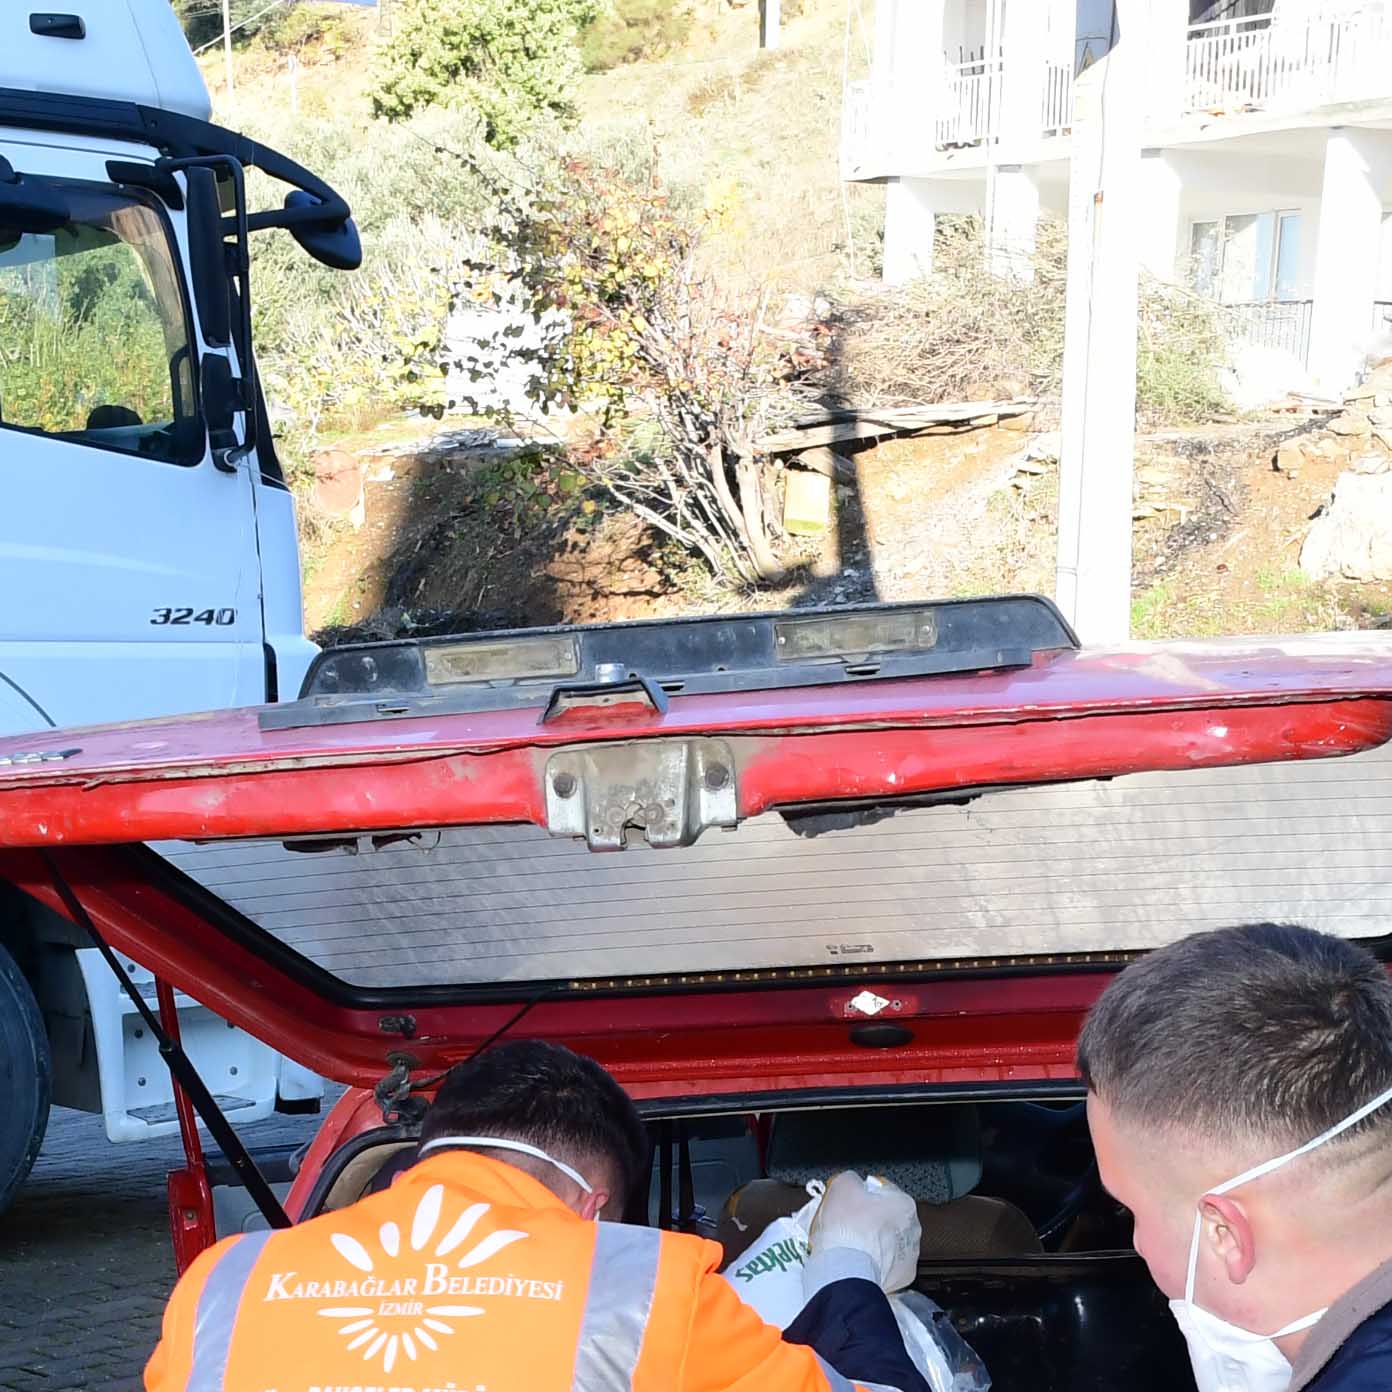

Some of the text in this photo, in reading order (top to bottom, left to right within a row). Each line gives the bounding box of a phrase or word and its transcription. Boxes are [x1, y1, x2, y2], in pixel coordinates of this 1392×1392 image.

[150, 608, 237, 626] 3240
[264, 1263, 564, 1302] KARABAĞLAR BELEDİYESİ
[378, 1301, 424, 1316] İZMİR
